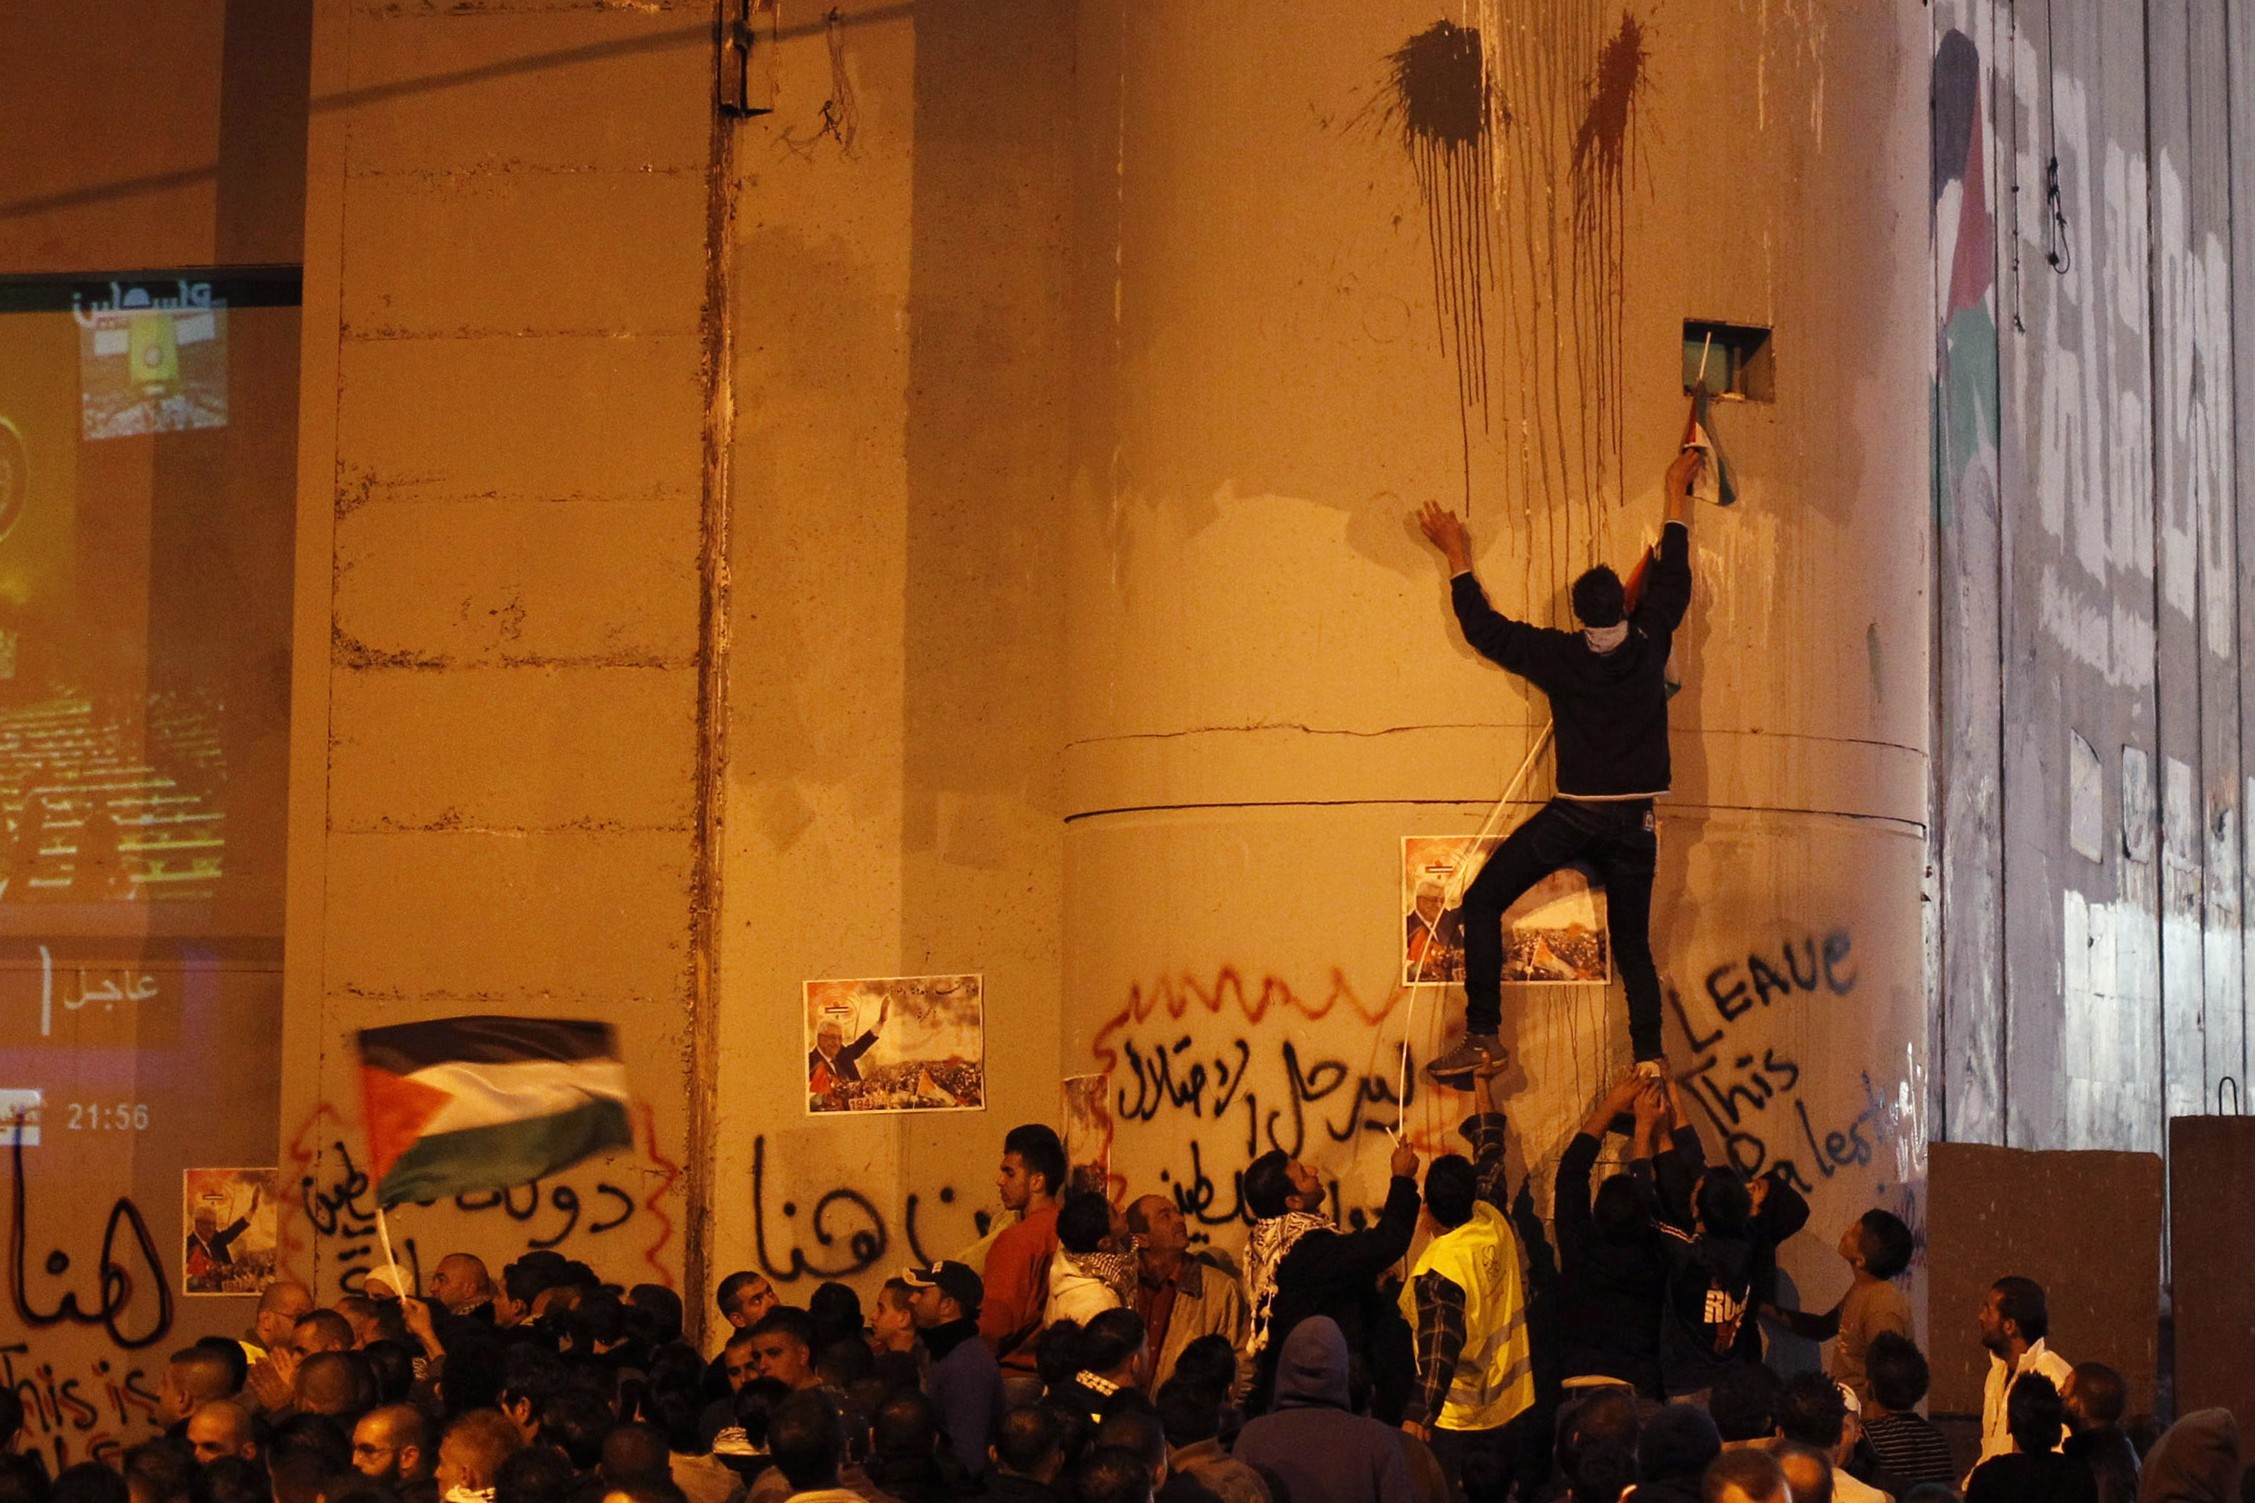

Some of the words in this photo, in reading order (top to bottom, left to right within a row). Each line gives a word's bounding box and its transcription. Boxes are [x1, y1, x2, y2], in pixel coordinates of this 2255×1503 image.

[63, 969, 159, 1012] عاجل
[1677, 1048, 1799, 1137] This
[67, 1103, 150, 1131] 21:56
